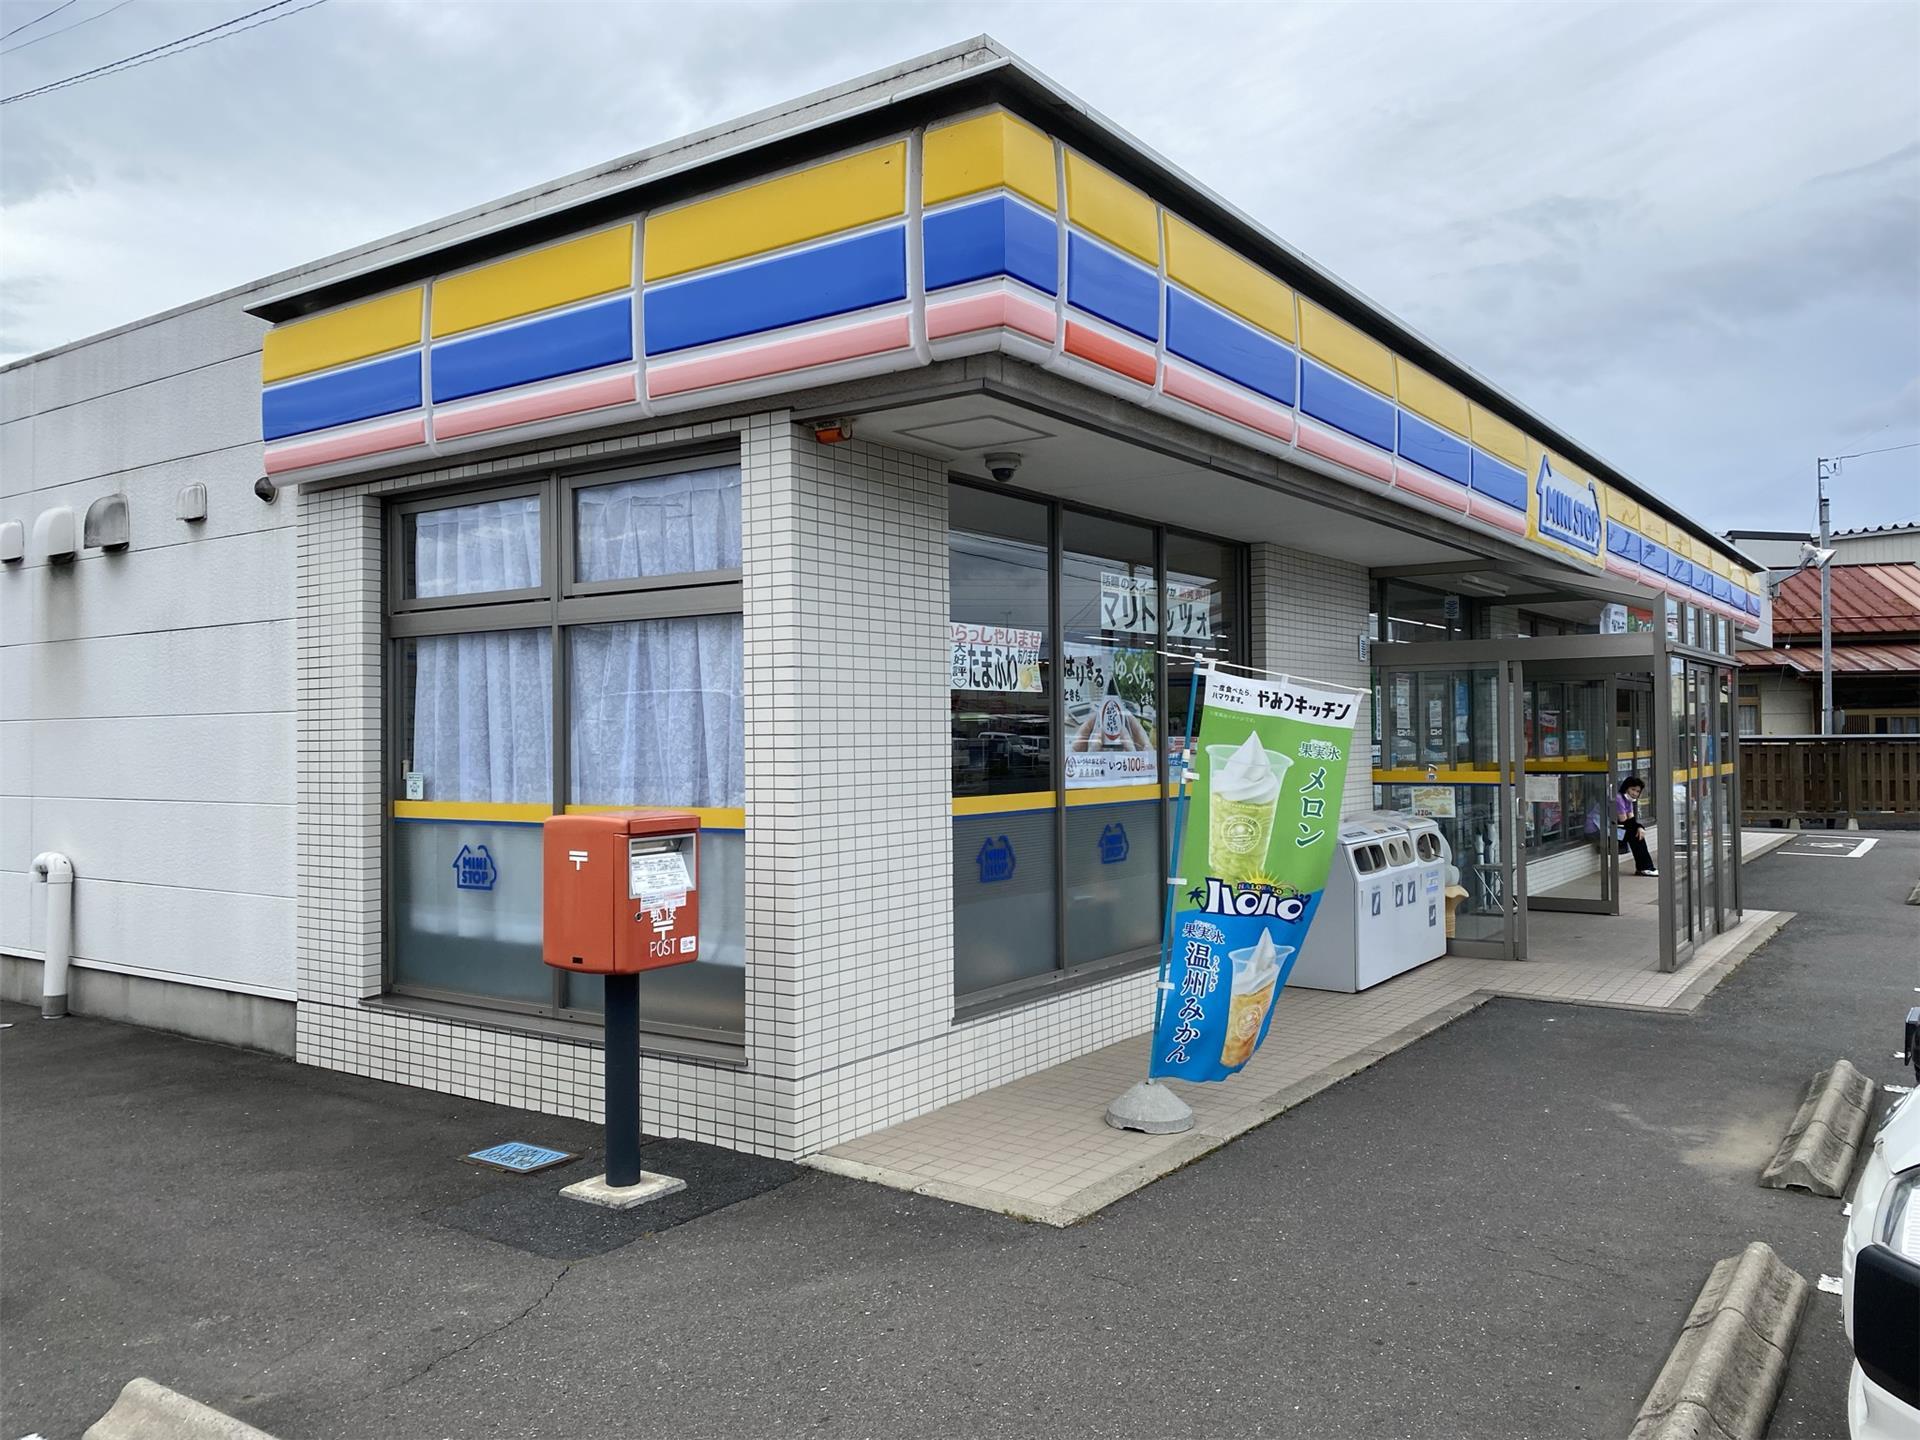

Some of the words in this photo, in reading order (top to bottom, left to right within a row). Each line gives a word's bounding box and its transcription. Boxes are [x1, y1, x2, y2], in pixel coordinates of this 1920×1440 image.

[1546, 486, 1573, 531] MINI
[1573, 500, 1598, 542] STOP
[967, 644, 1018, 690] たまふわ
[1257, 690, 1351, 720] やみつキッチン
[1299, 742, 1341, 761] 果実氷
[1296, 767, 1328, 848] メロン
[462, 857, 488, 870] MINI
[462, 870, 489, 884] STOP
[1183, 922, 1226, 944] 果実氷
[650, 938, 677, 958] POST
[1165, 941, 1211, 1064] 温州みかん
